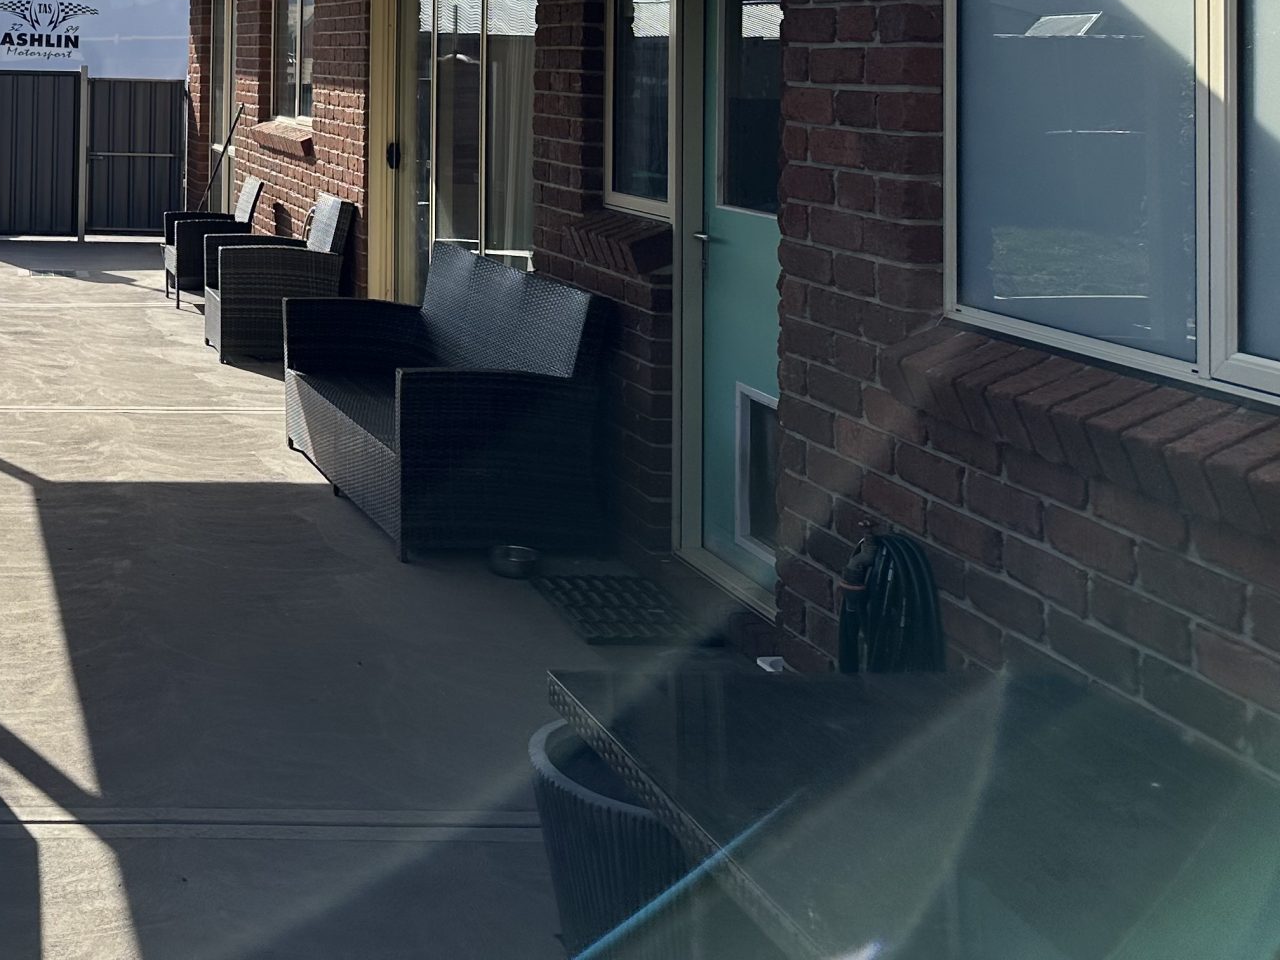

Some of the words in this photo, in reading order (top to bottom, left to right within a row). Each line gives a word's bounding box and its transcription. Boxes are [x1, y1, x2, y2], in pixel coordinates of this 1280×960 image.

[38, 3, 53, 14] TAS
[8, 23, 24, 32] 32
[0, 32, 79, 49] ASHLIN
[6, 46, 72, 59] Motorsport
